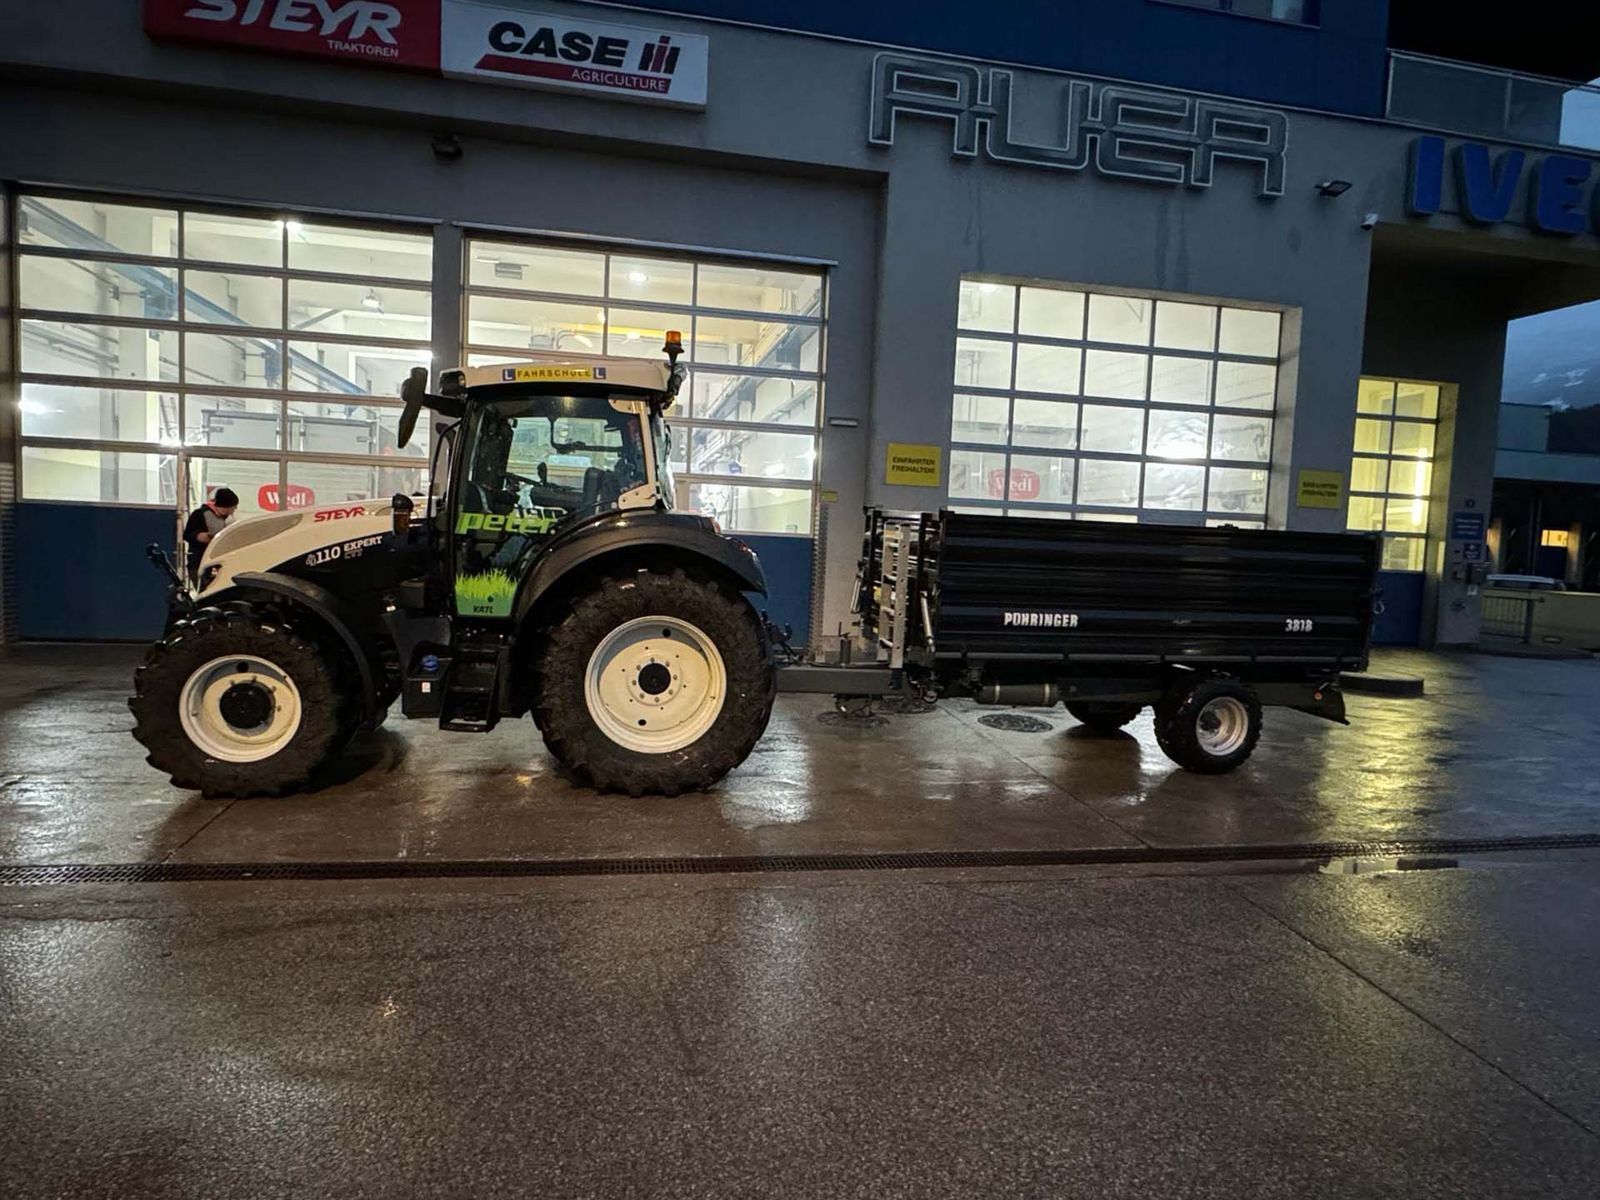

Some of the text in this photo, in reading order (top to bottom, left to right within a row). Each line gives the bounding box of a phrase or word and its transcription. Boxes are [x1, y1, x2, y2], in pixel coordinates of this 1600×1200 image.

[183, 0, 402, 44] STEYR
[327, 39, 399, 58] TRAKTOREN
[488, 21, 630, 68] CASE
[571, 69, 667, 92] AGRICULTURE
[868, 51, 1289, 197] AUER
[1405, 135, 1600, 237] IVE
[516, 368, 591, 378] FAHRSCHULE
[314, 506, 366, 522] STEYR
[343, 536, 383, 552] EXPERT
